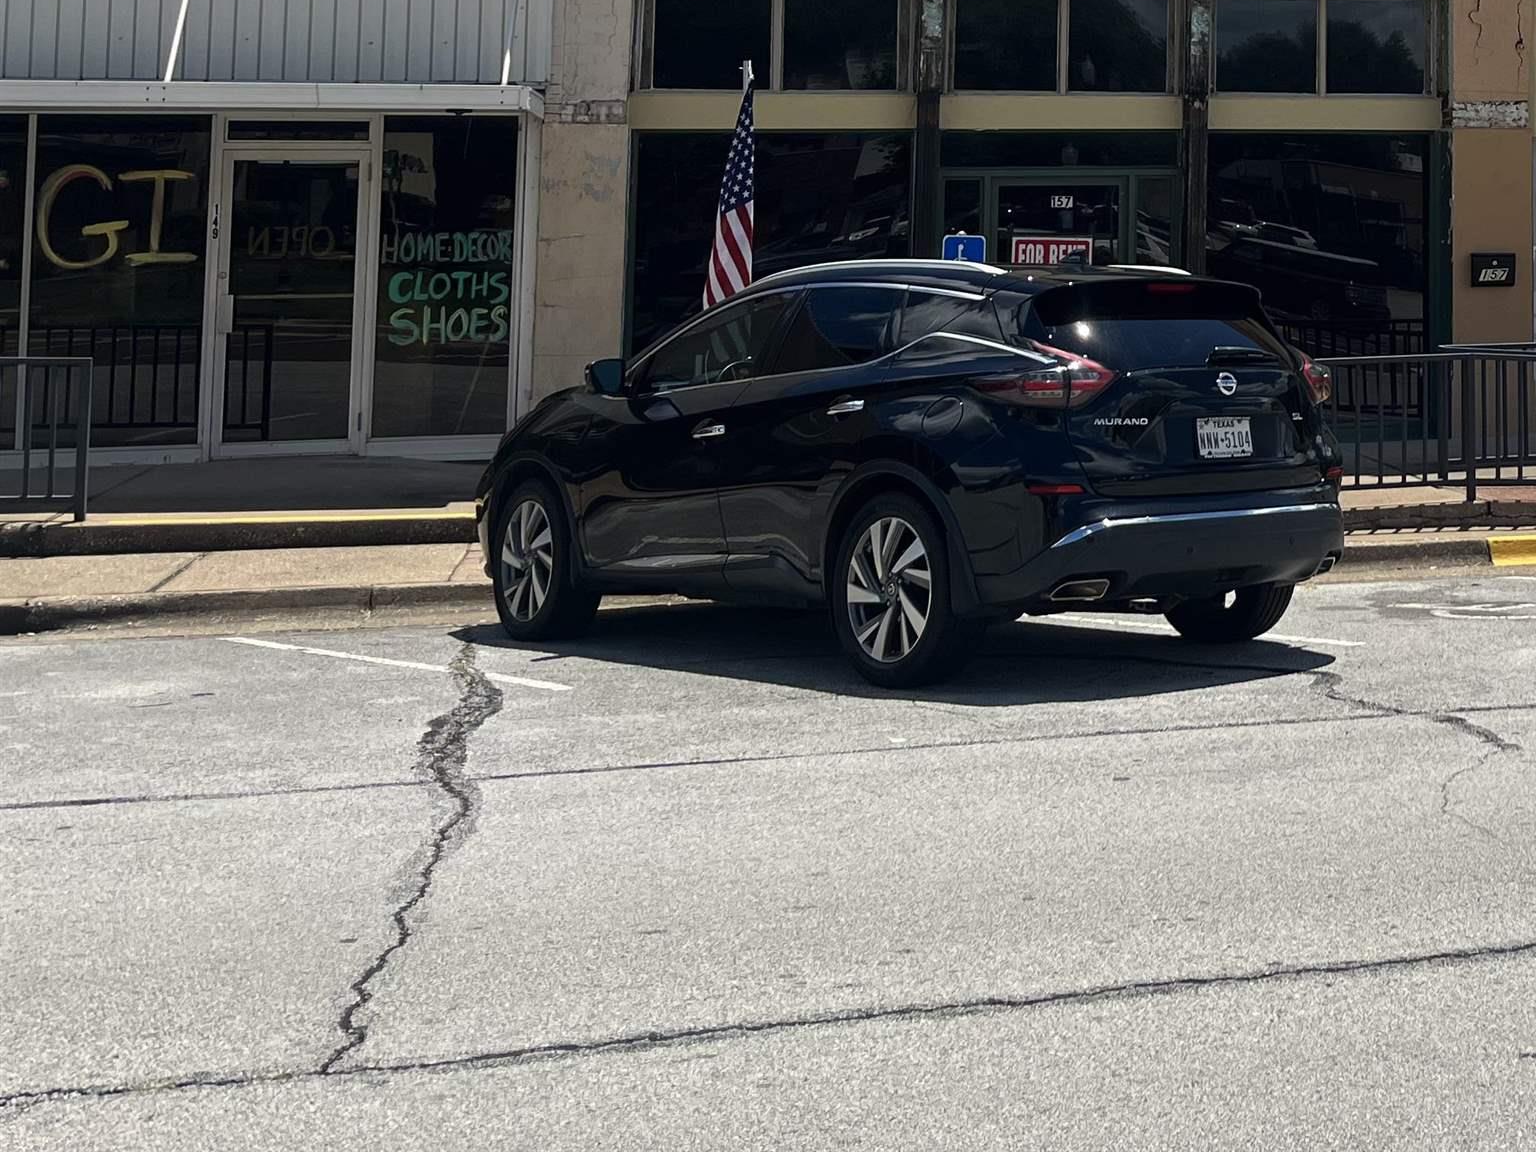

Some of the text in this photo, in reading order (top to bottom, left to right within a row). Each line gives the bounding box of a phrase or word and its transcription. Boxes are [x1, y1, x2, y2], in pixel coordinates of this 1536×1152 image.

[1051, 196, 1073, 208] 157
[381, 230, 513, 264] HOME DECOR
[1018, 243, 1086, 264] FOR RE
[1479, 268, 1509, 282] 157
[388, 271, 510, 304] CLOTHS
[389, 305, 509, 346] SHOES
[1094, 417, 1149, 425] MURANO
[1213, 419, 1235, 428] TEXAS
